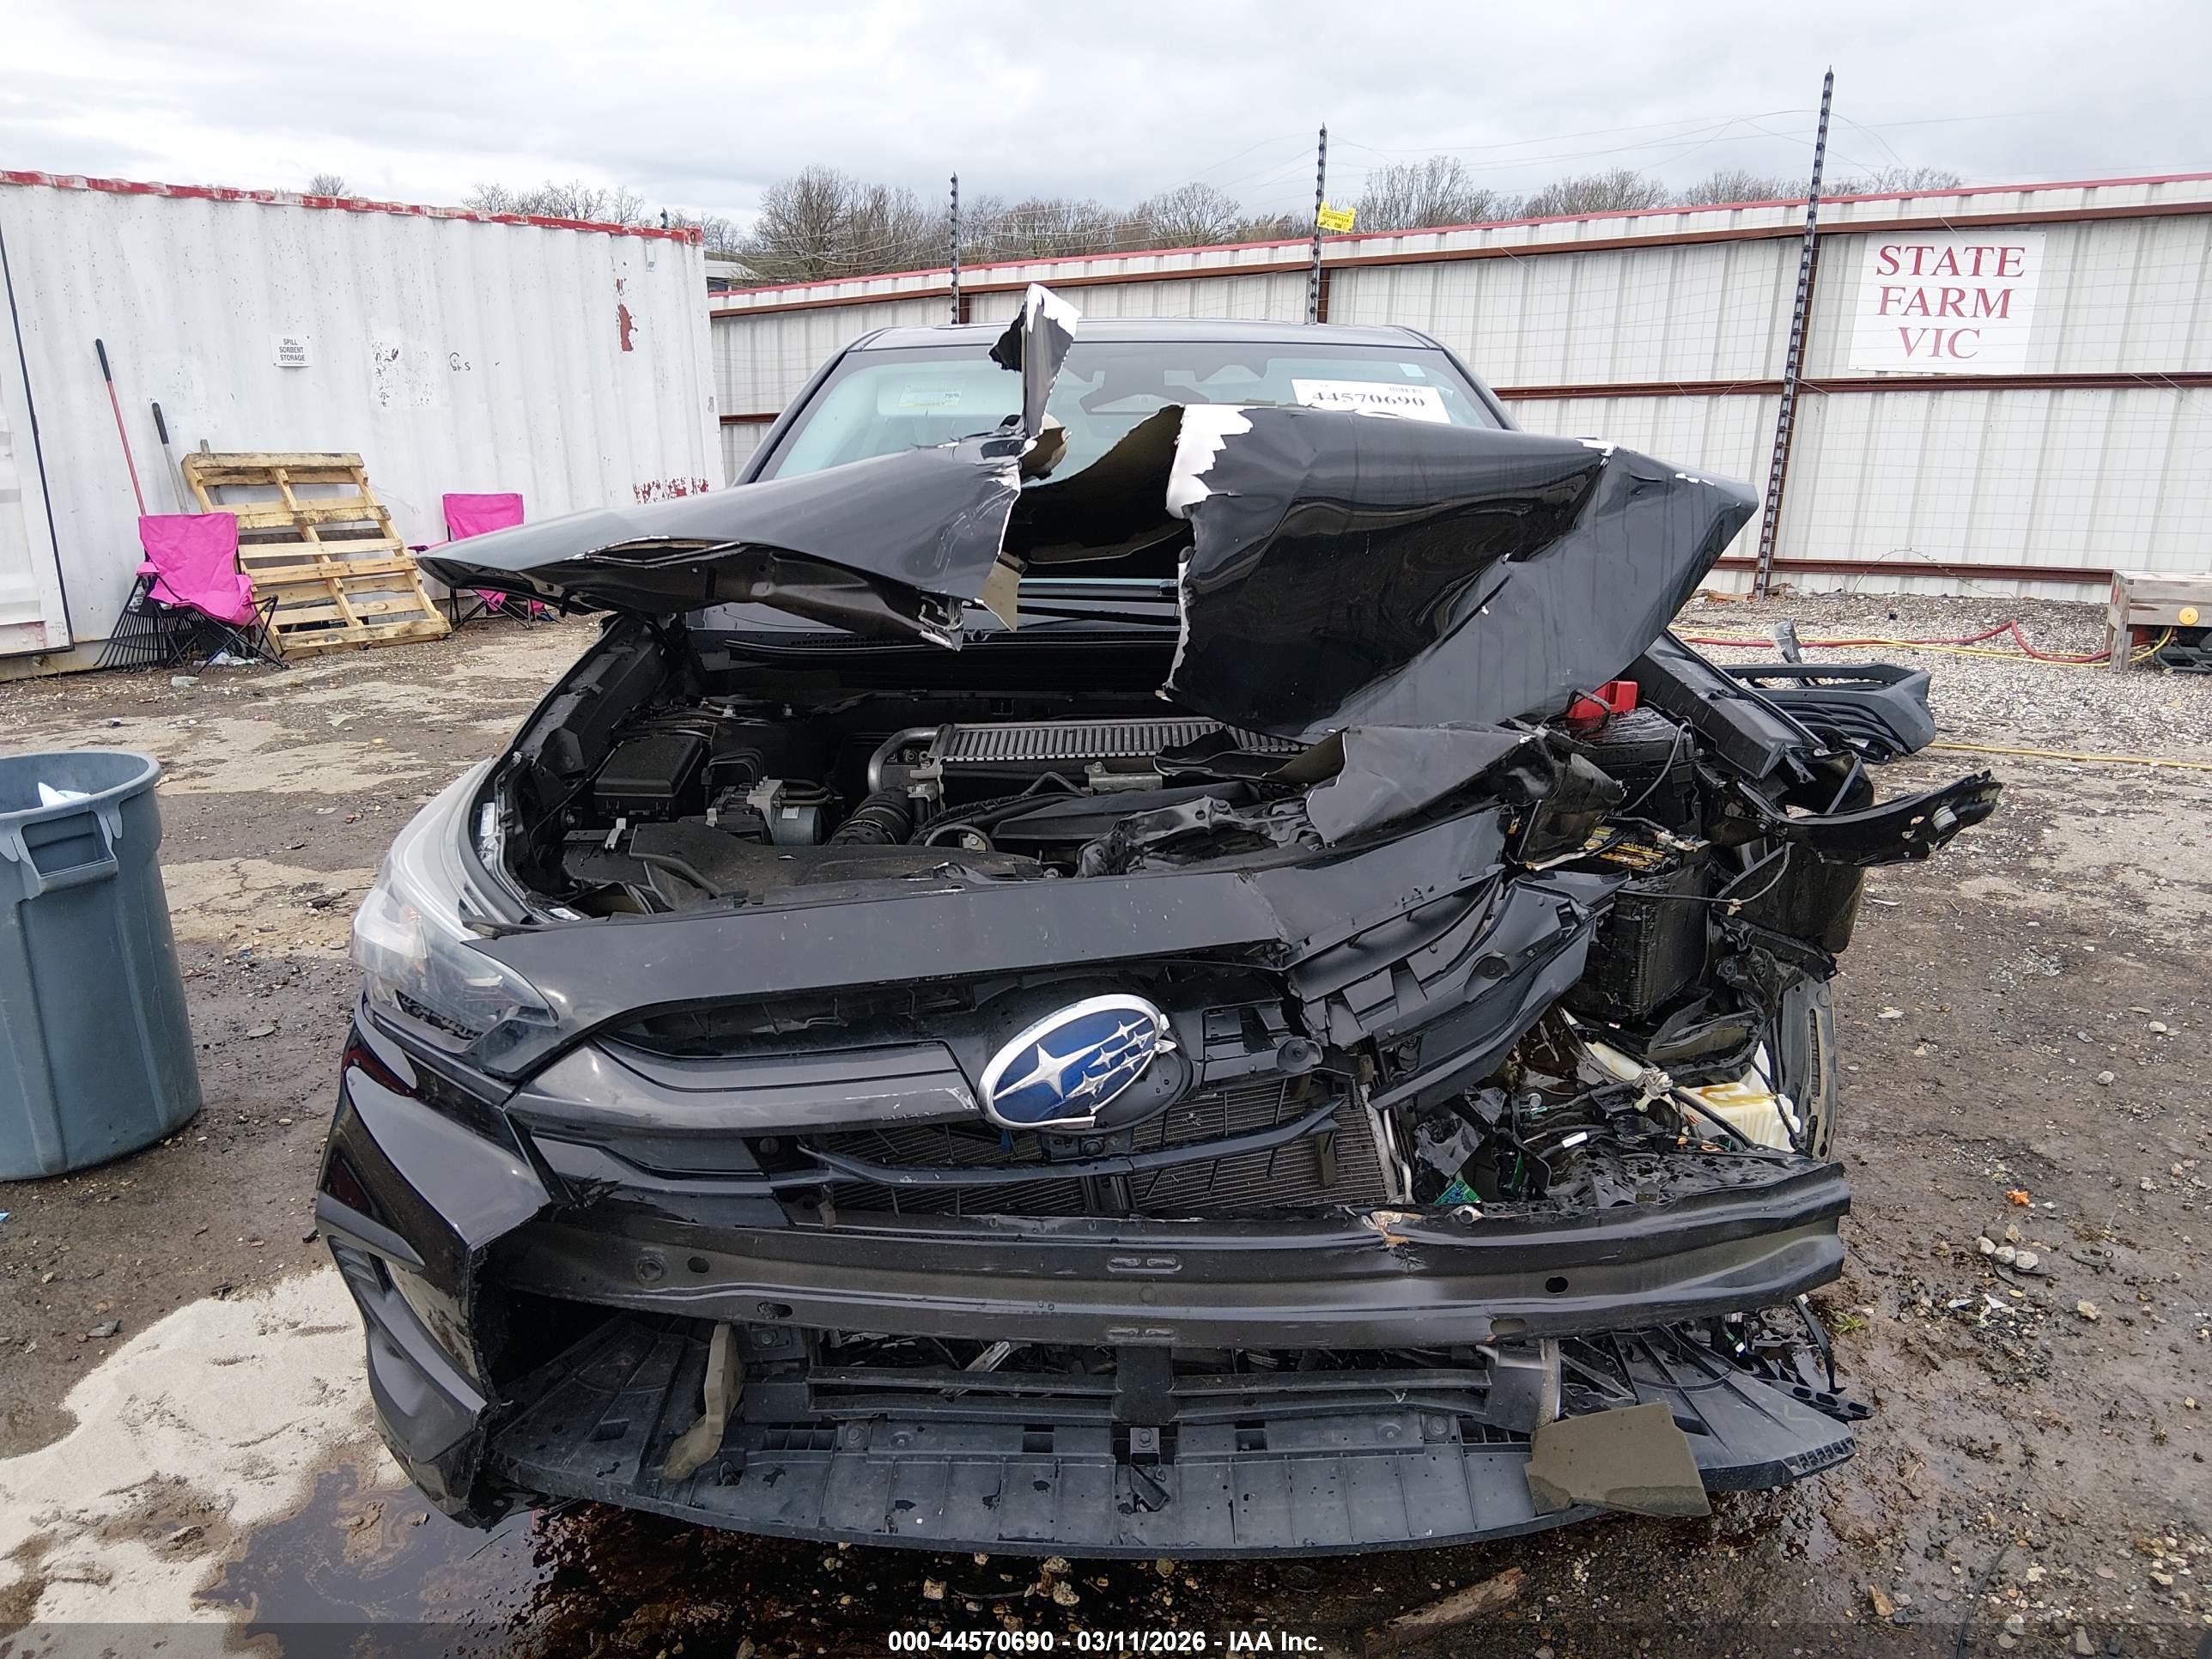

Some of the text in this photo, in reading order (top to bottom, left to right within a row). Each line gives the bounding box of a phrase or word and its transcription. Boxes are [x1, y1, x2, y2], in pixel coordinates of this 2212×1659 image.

[1876, 245, 2026, 277] STATE
[1875, 286, 2015, 319] FARM
[1898, 326, 1981, 359] VIC
[1312, 391, 1425, 407] 44570690
